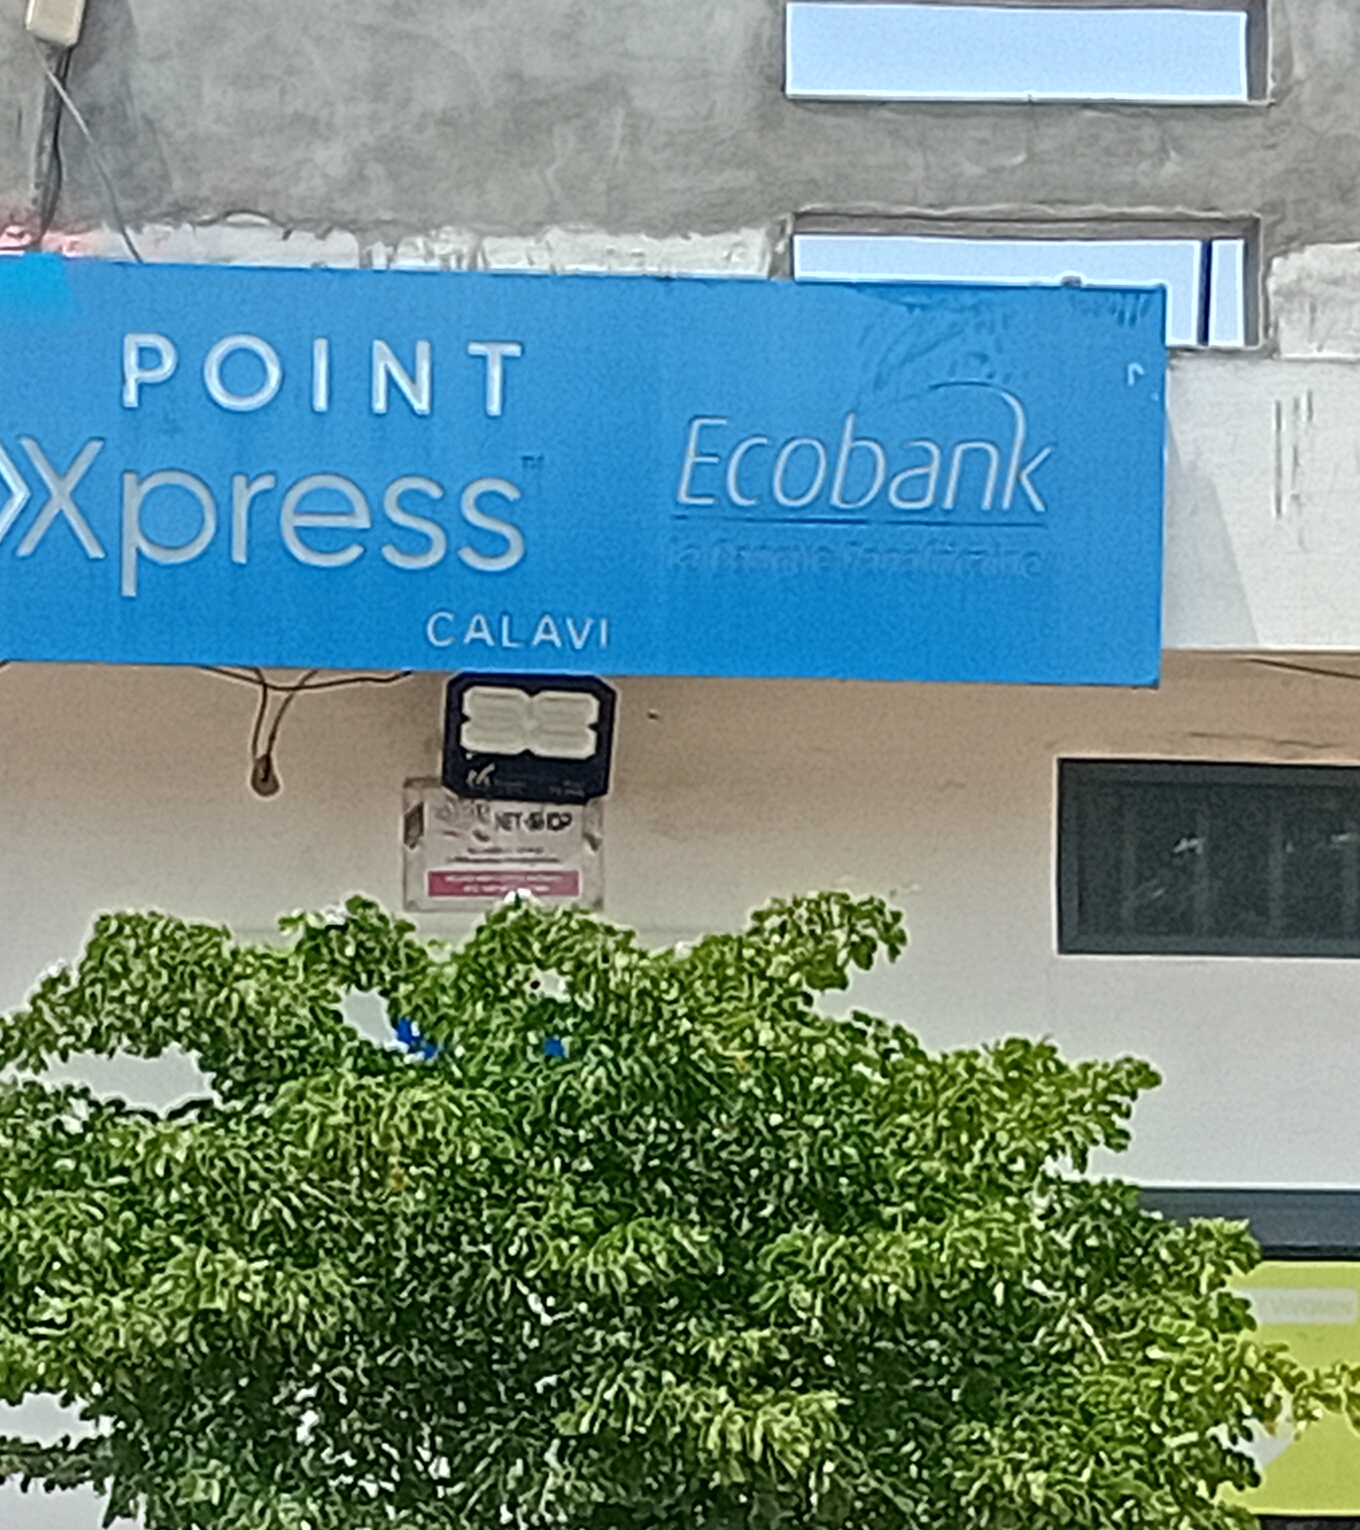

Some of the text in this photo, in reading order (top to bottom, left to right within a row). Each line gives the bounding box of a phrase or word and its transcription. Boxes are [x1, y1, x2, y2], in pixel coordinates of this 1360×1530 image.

[121, 332, 523, 418] POINT
[675, 381, 1057, 514] Ecobank
[16, 435, 526, 598] Xpress
[426, 611, 610, 651] CALAVI
